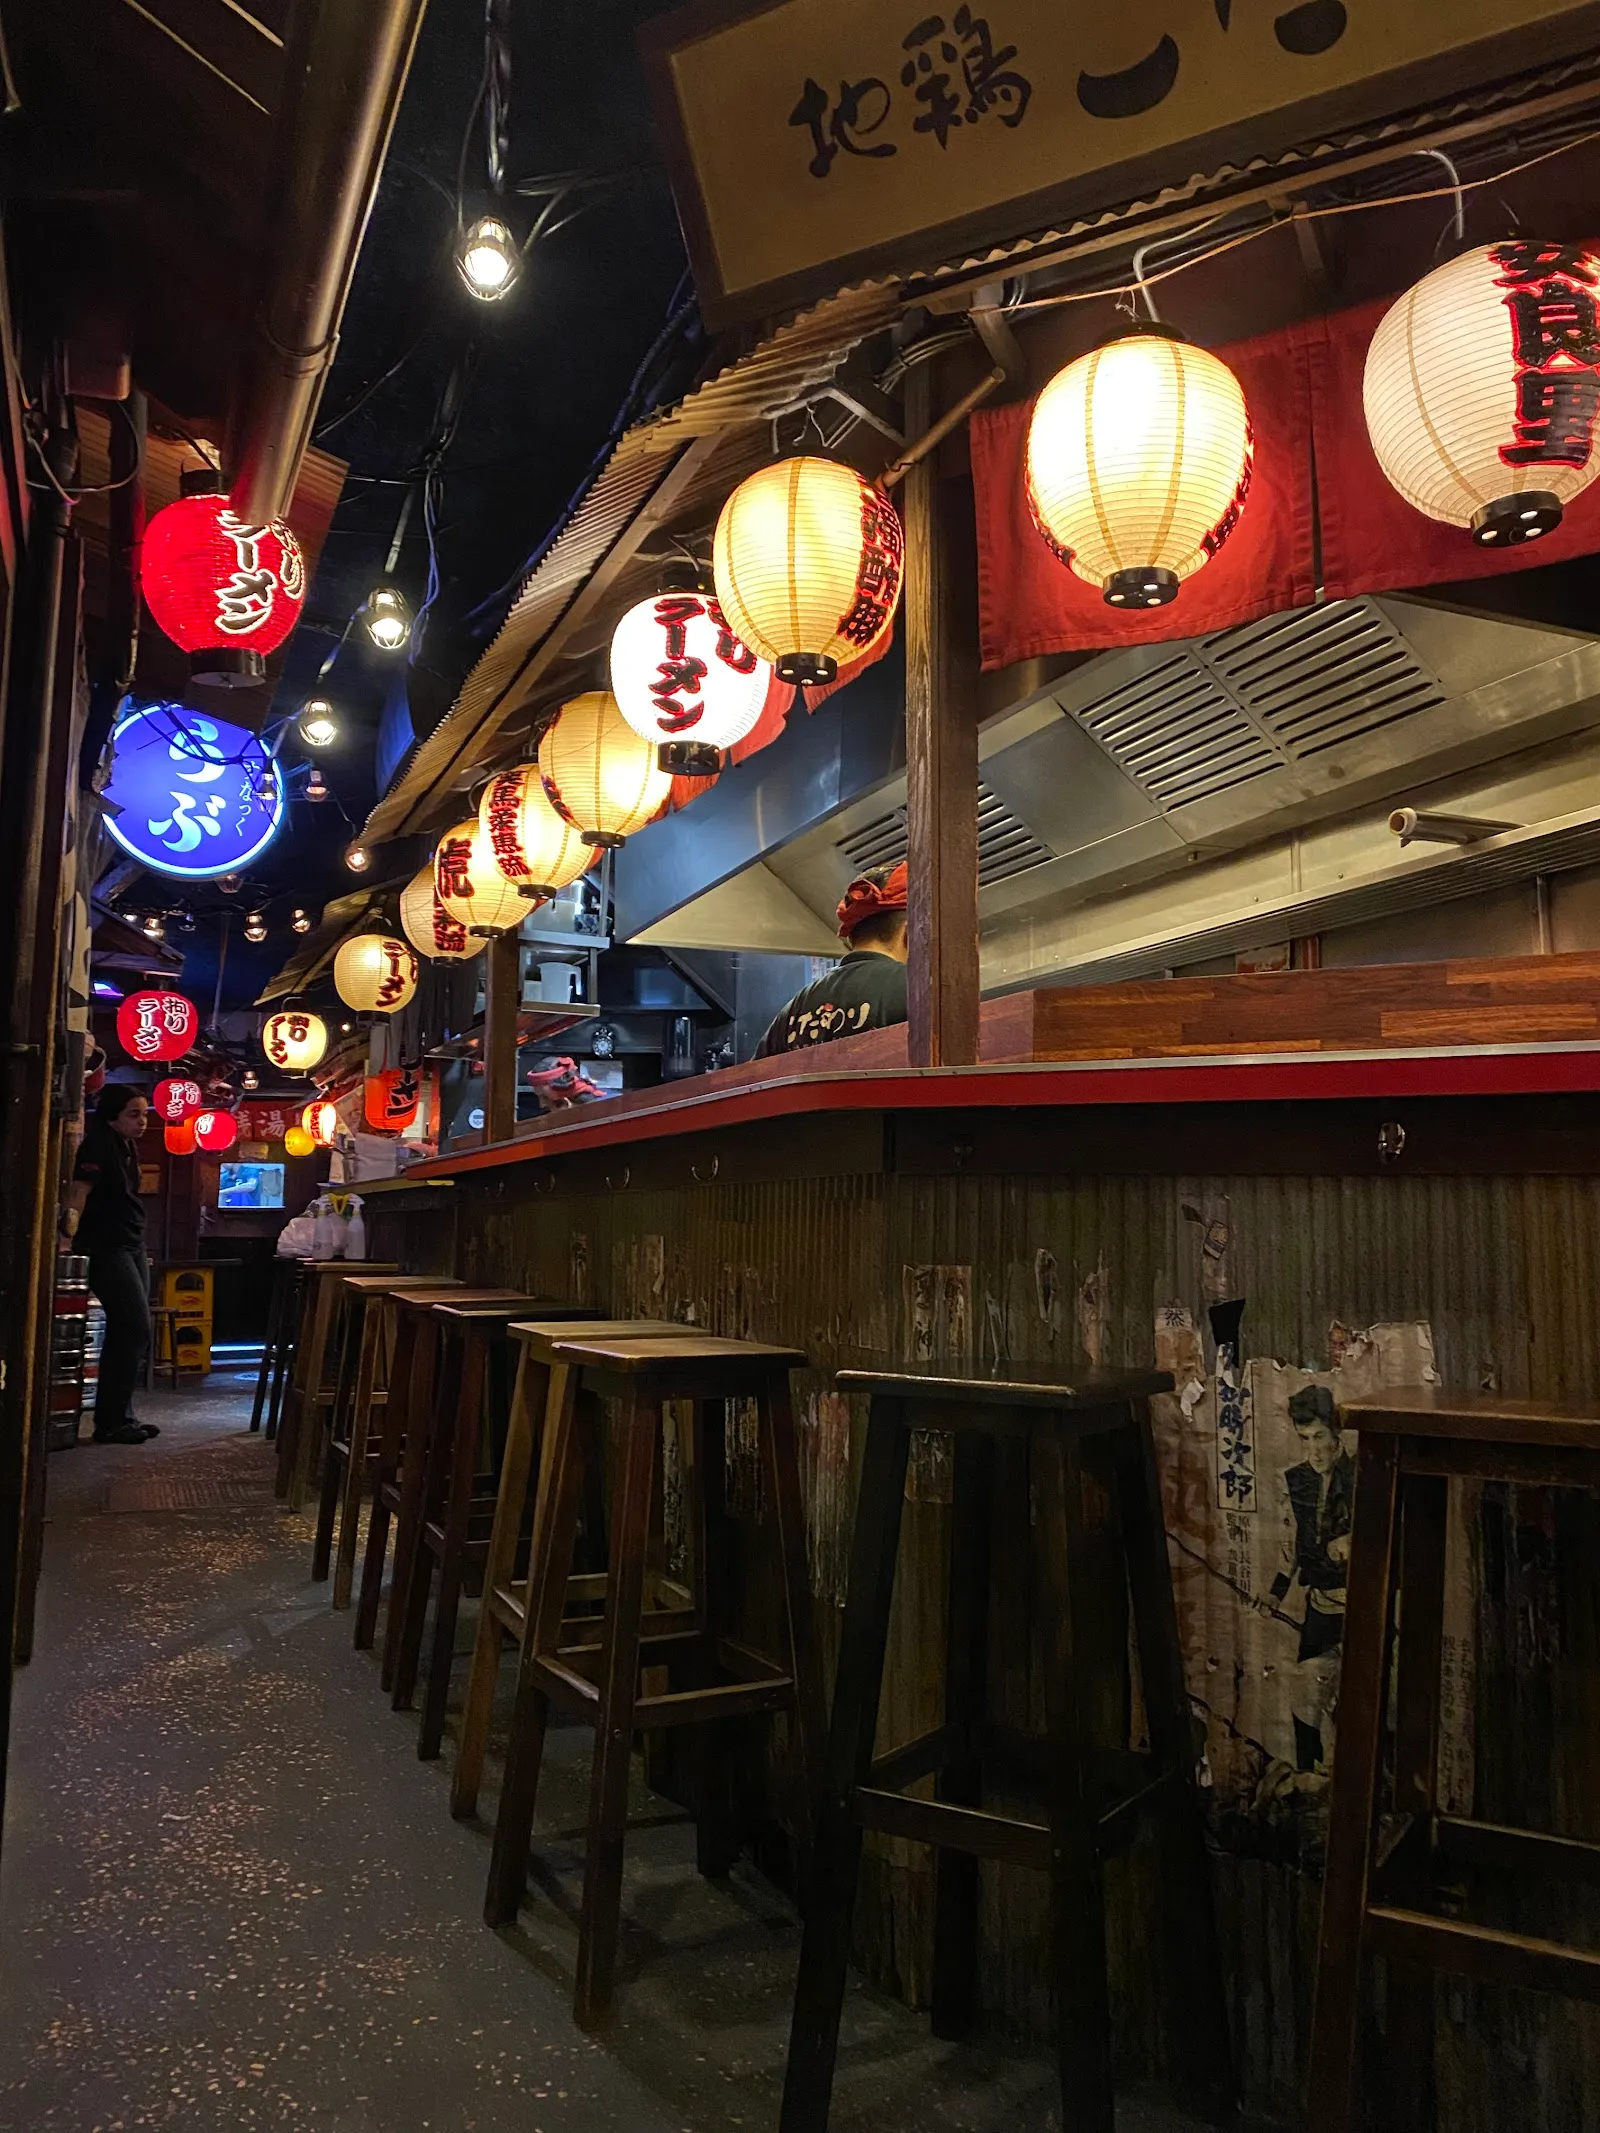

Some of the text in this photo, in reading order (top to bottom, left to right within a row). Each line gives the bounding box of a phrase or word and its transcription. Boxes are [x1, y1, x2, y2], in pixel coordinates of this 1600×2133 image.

[789, 7, 1033, 178] 地鶏
[213, 509, 278, 634] ラーメン
[648, 597, 708, 733] ラーメン
[147, 718, 227, 853] らぶ
[162, 996, 190, 1036] 拘り
[375, 940, 408, 1008] ラーメン
[133, 998, 163, 1054] ラーメン
[166, 1082, 185, 1118] ラーメン
